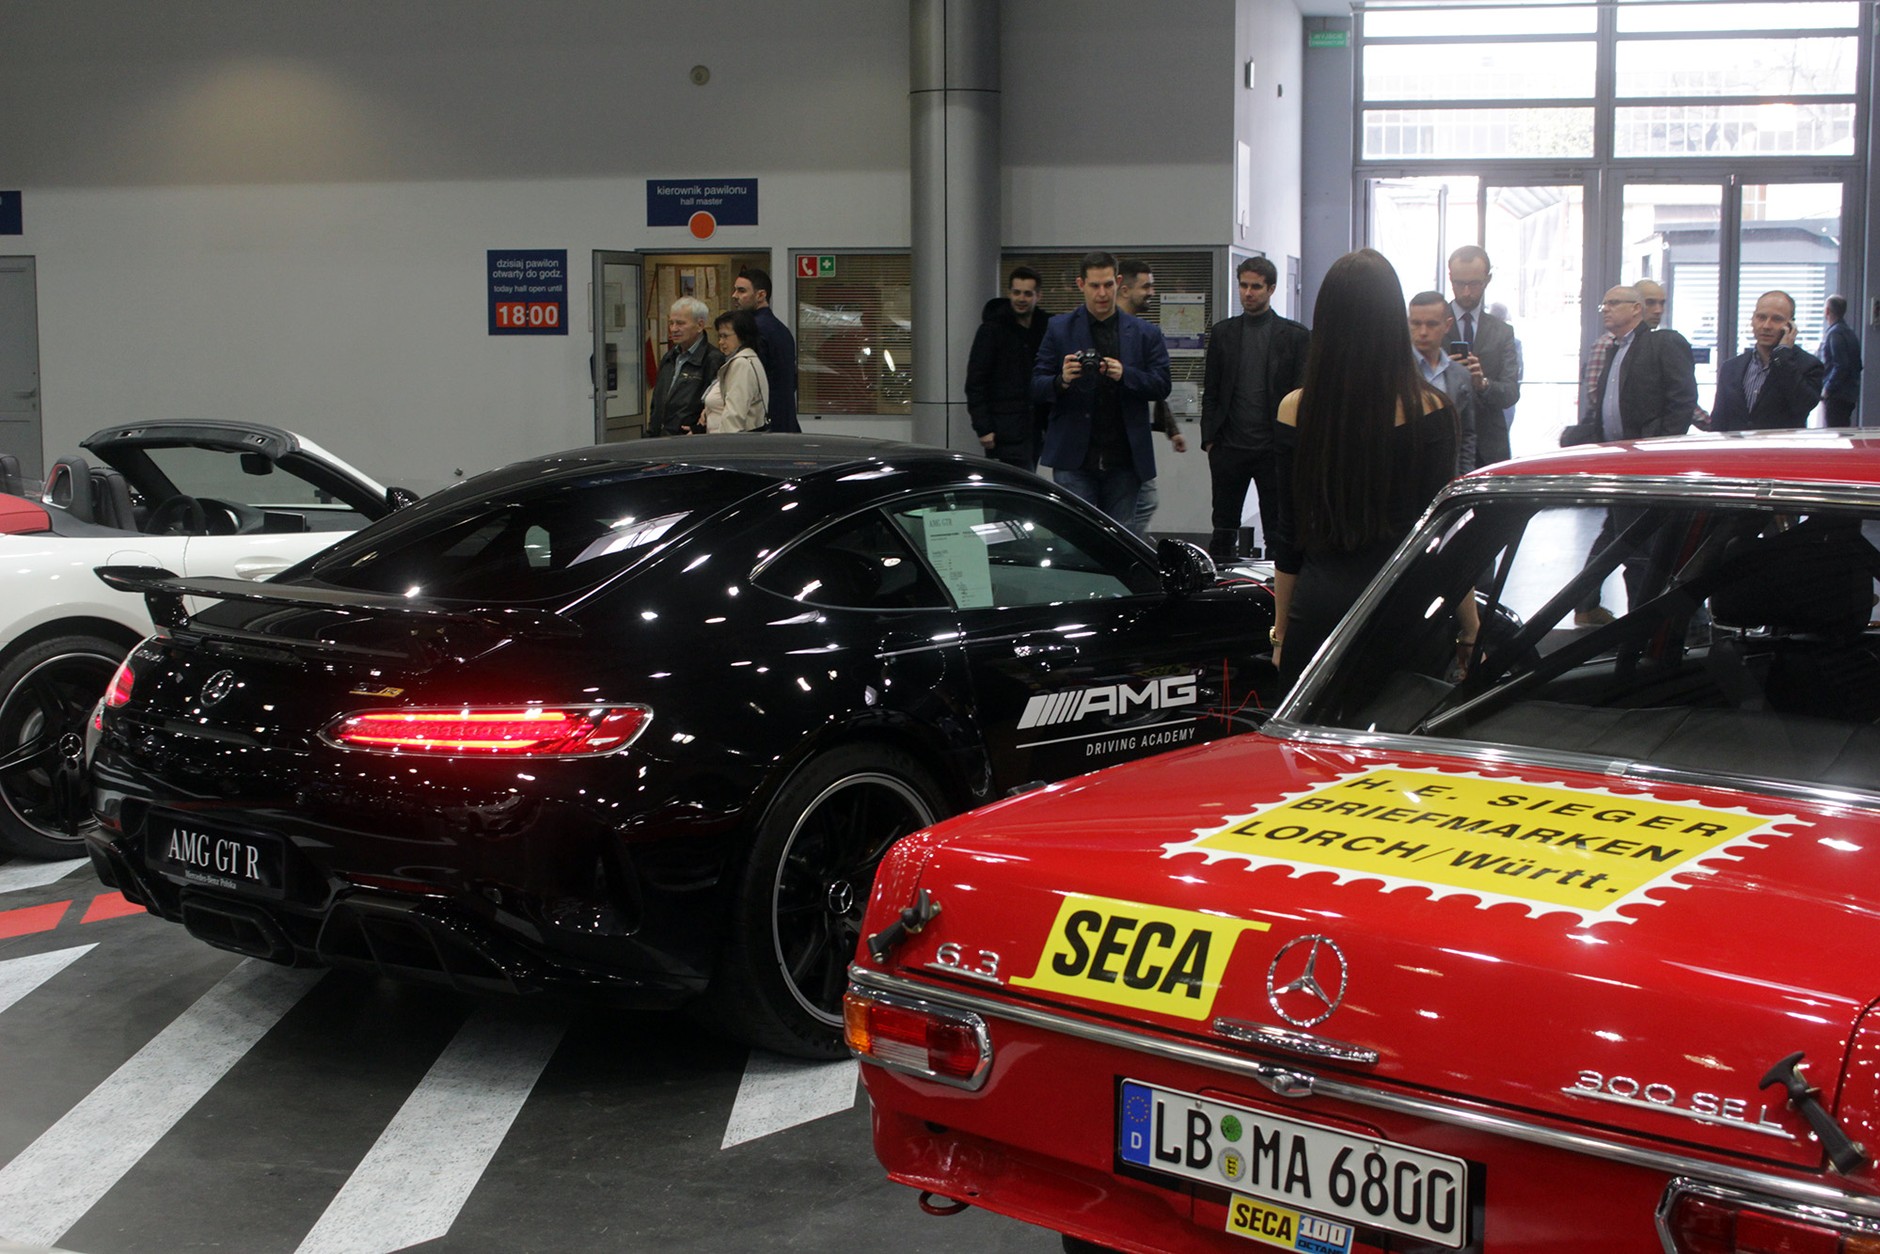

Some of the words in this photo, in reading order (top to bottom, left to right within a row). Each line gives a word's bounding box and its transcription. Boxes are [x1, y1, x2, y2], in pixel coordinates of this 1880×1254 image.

[656, 185, 702, 195] kierownik
[704, 185, 747, 196] pawilonu
[680, 198, 695, 206] hall
[696, 198, 723, 206] master
[492, 270, 524, 280] otwarty
[526, 270, 537, 278] do
[539, 270, 563, 280] godz.
[496, 259, 524, 269] dzisiaj
[526, 259, 559, 269] pawilon
[493, 285, 513, 294] today
[528, 286, 546, 294] open
[499, 305, 558, 325] 18:00
[1073, 674, 1197, 722] AMG
[1086, 736, 1136, 757] DRIVING
[1141, 727, 1196, 748] ACADEMY
[1345, 777, 1396, 793] H.
[1409, 785, 1459, 800] E.
[1487, 794, 1729, 838] SIEGER
[1289, 797, 1684, 863] BRIEFMARKEN
[168, 828, 210, 868] AMG
[215, 839, 241, 875] GT
[245, 844, 260, 880] R
[936, 942, 1001, 977] 6.3
[1052, 909, 1213, 1000] SECA
[1574, 1069, 1677, 1106] 300
[1130, 1131, 1143, 1150] D
[1155, 1101, 1213, 1170] LB
[1252, 1124, 1312, 1199] MA
[1328, 1146, 1456, 1235] 6800
[1234, 1202, 1292, 1242] SECA
[1299, 1217, 1348, 1248] 100
